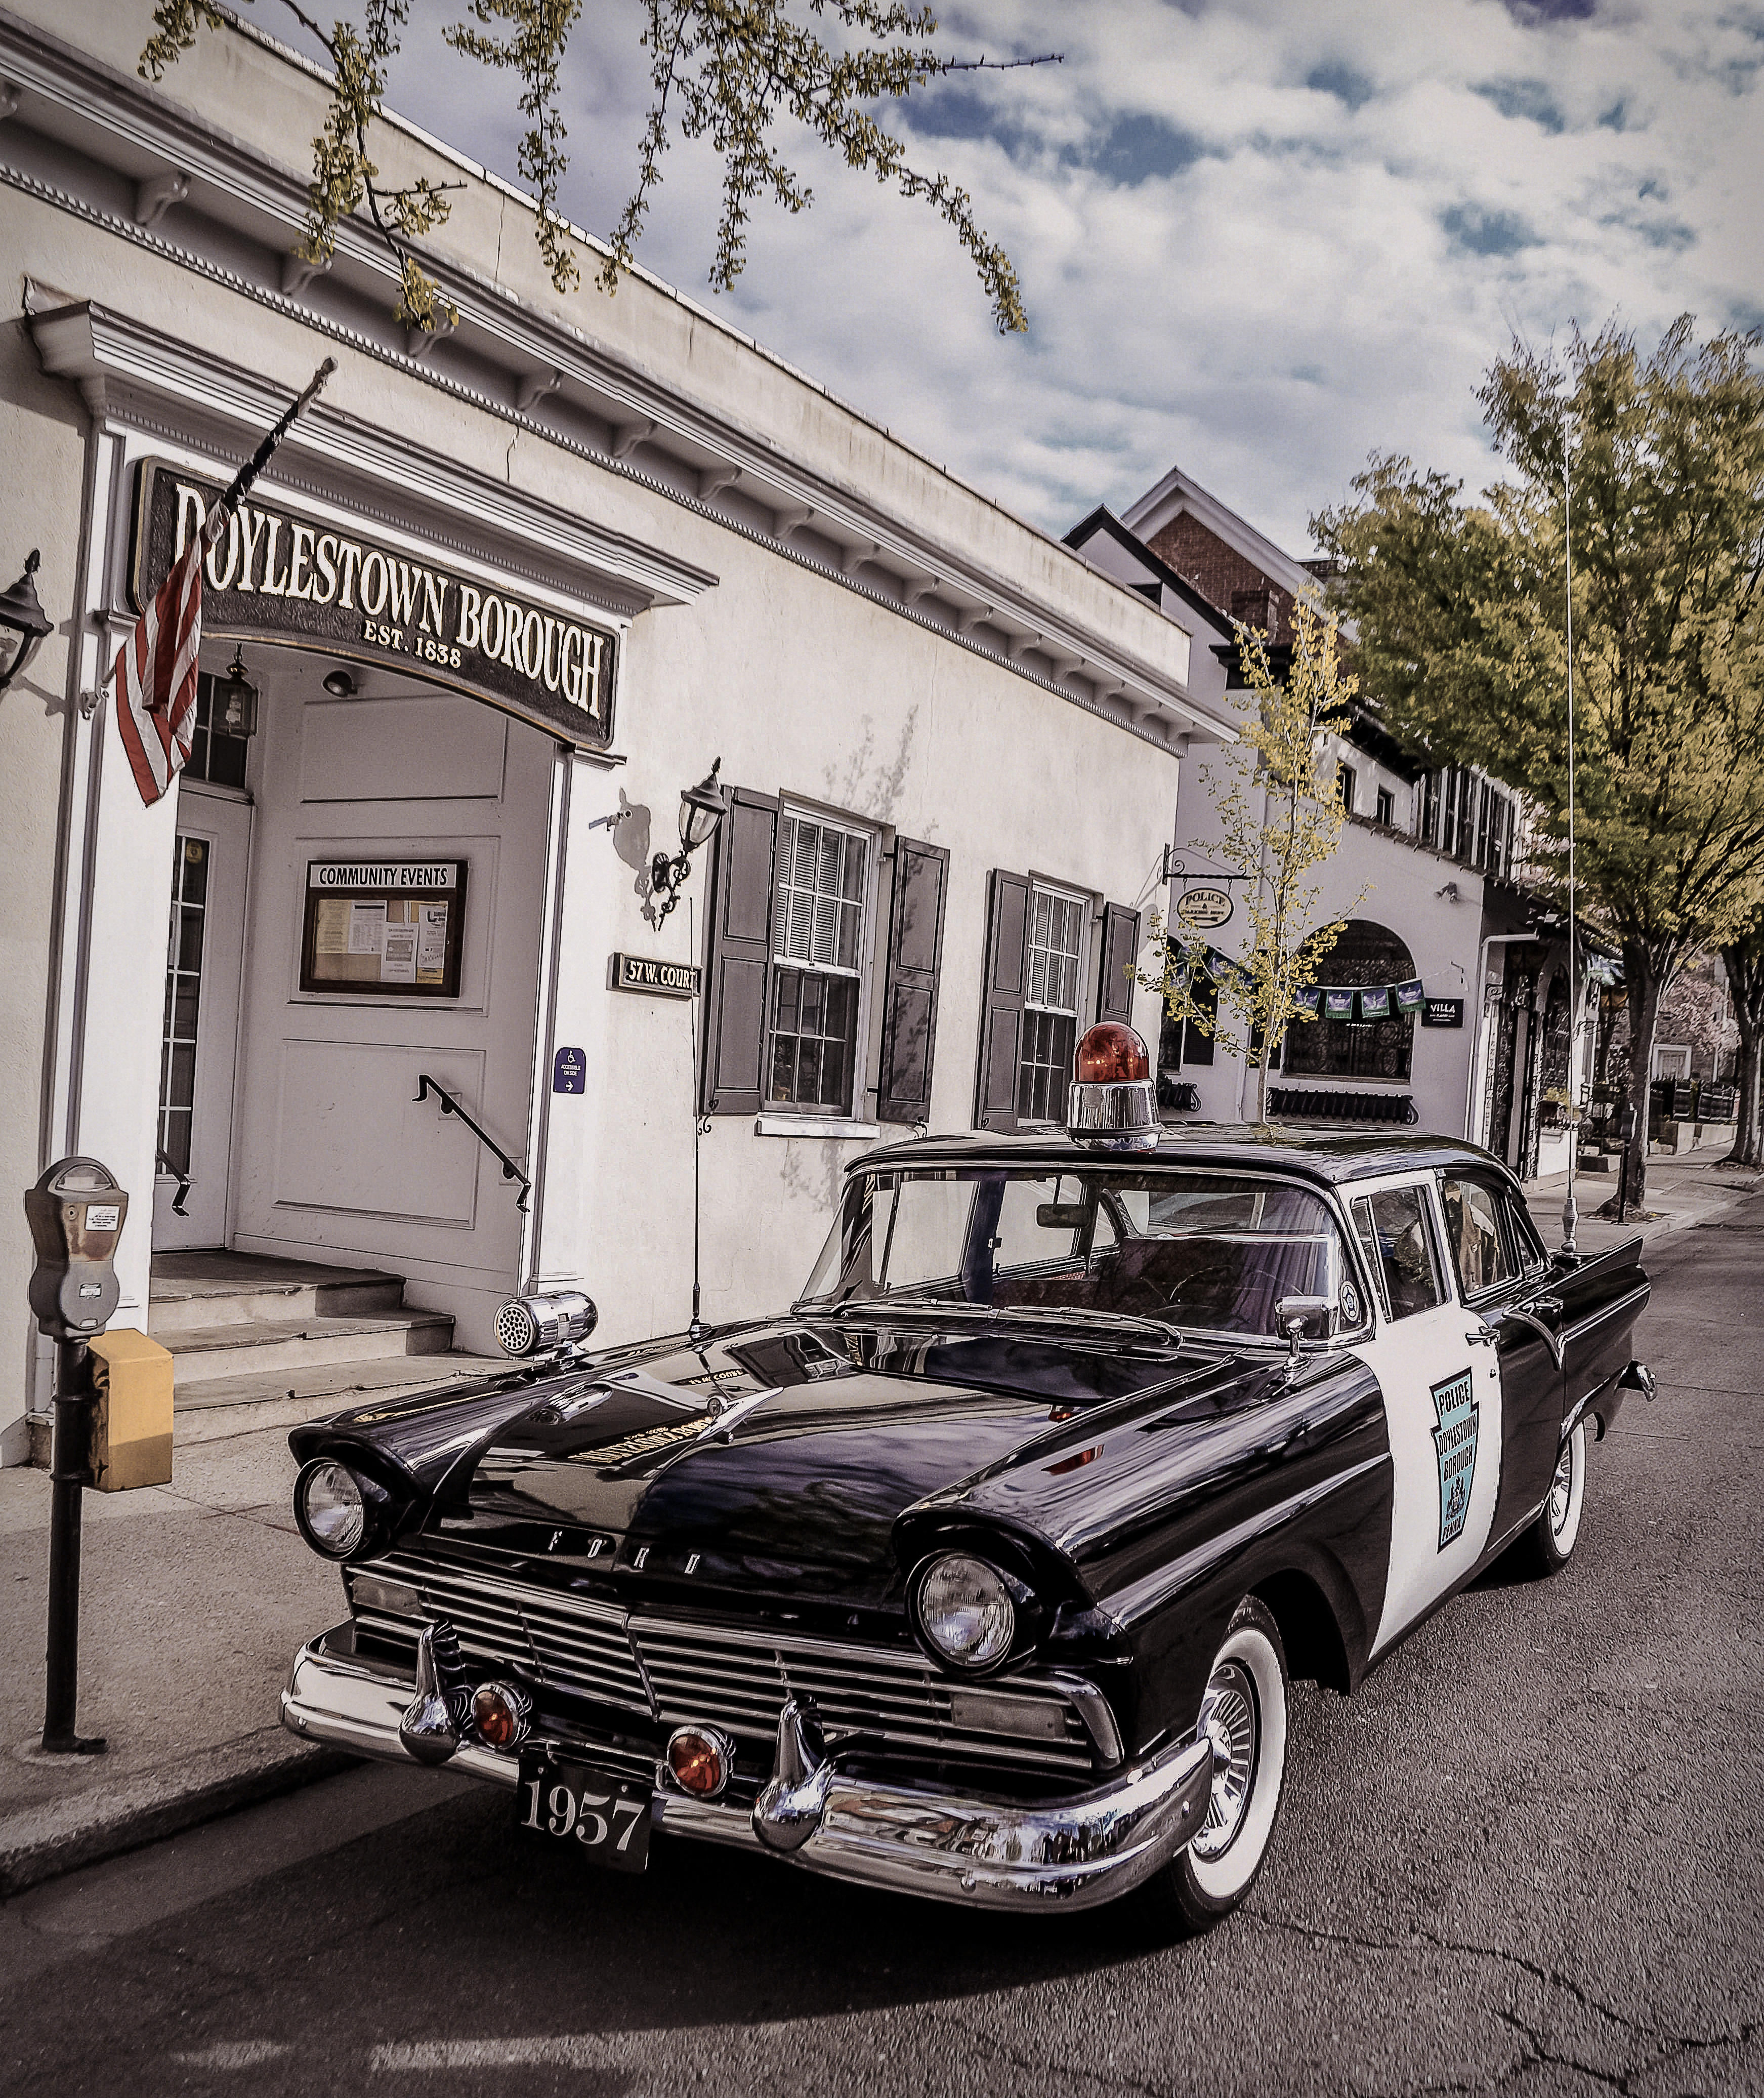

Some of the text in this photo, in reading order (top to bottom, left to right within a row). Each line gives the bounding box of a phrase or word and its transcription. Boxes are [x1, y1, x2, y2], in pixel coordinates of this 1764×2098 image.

[175, 483, 604, 720] DOYLESTOWN BOROUGH
[363, 619, 462, 669] EST. 1838
[319, 867, 448, 886] COMMUNITY EVENTS
[1185, 891, 1226, 907] POLICE
[628, 960, 697, 989] 57 W. COURT
[1430, 1004, 1455, 1014] VILLA
[1438, 1380, 1470, 1416] POLICE
[1438, 1413, 1477, 1457] DOYLESTOWN
[1443, 1443, 1474, 1482] BOROUGH
[548, 1531, 701, 1575] FORD
[520, 1780, 645, 1851] 1957
